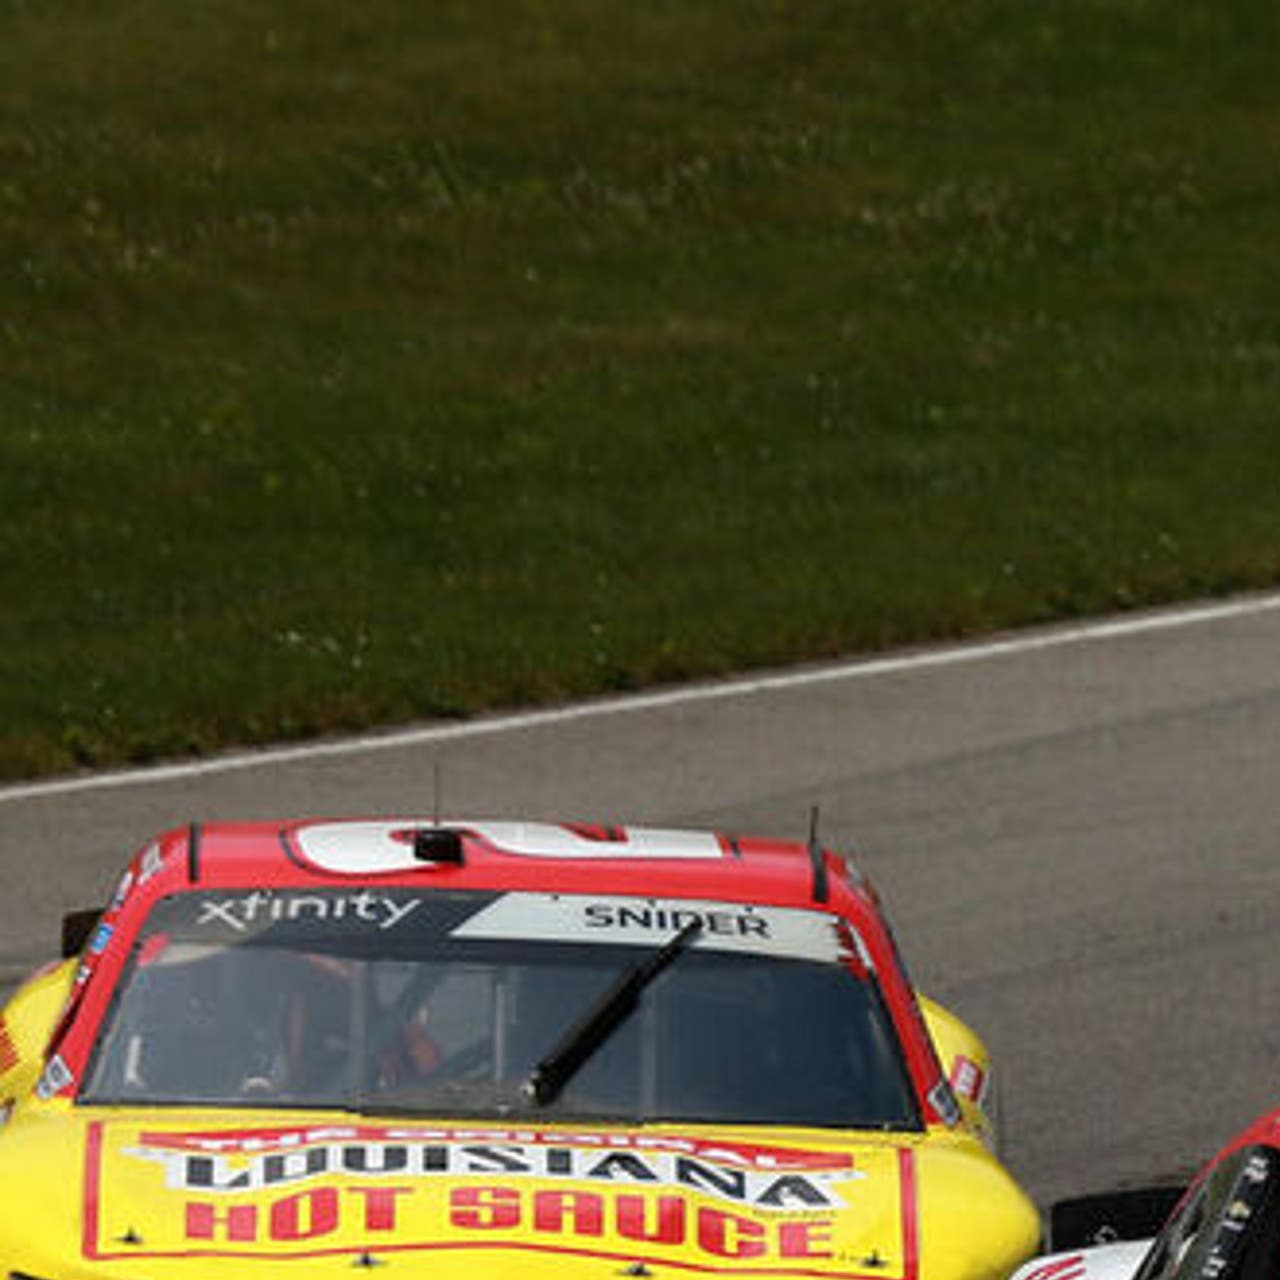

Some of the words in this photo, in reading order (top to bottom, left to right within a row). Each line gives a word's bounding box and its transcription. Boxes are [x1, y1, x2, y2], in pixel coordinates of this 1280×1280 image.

[199, 888, 422, 930] xfinity
[584, 903, 771, 939] SNIDER
[184, 1144, 834, 1206] LOUISIANA
[184, 1185, 414, 1244] HOT
[448, 1185, 836, 1261] SAUCE
